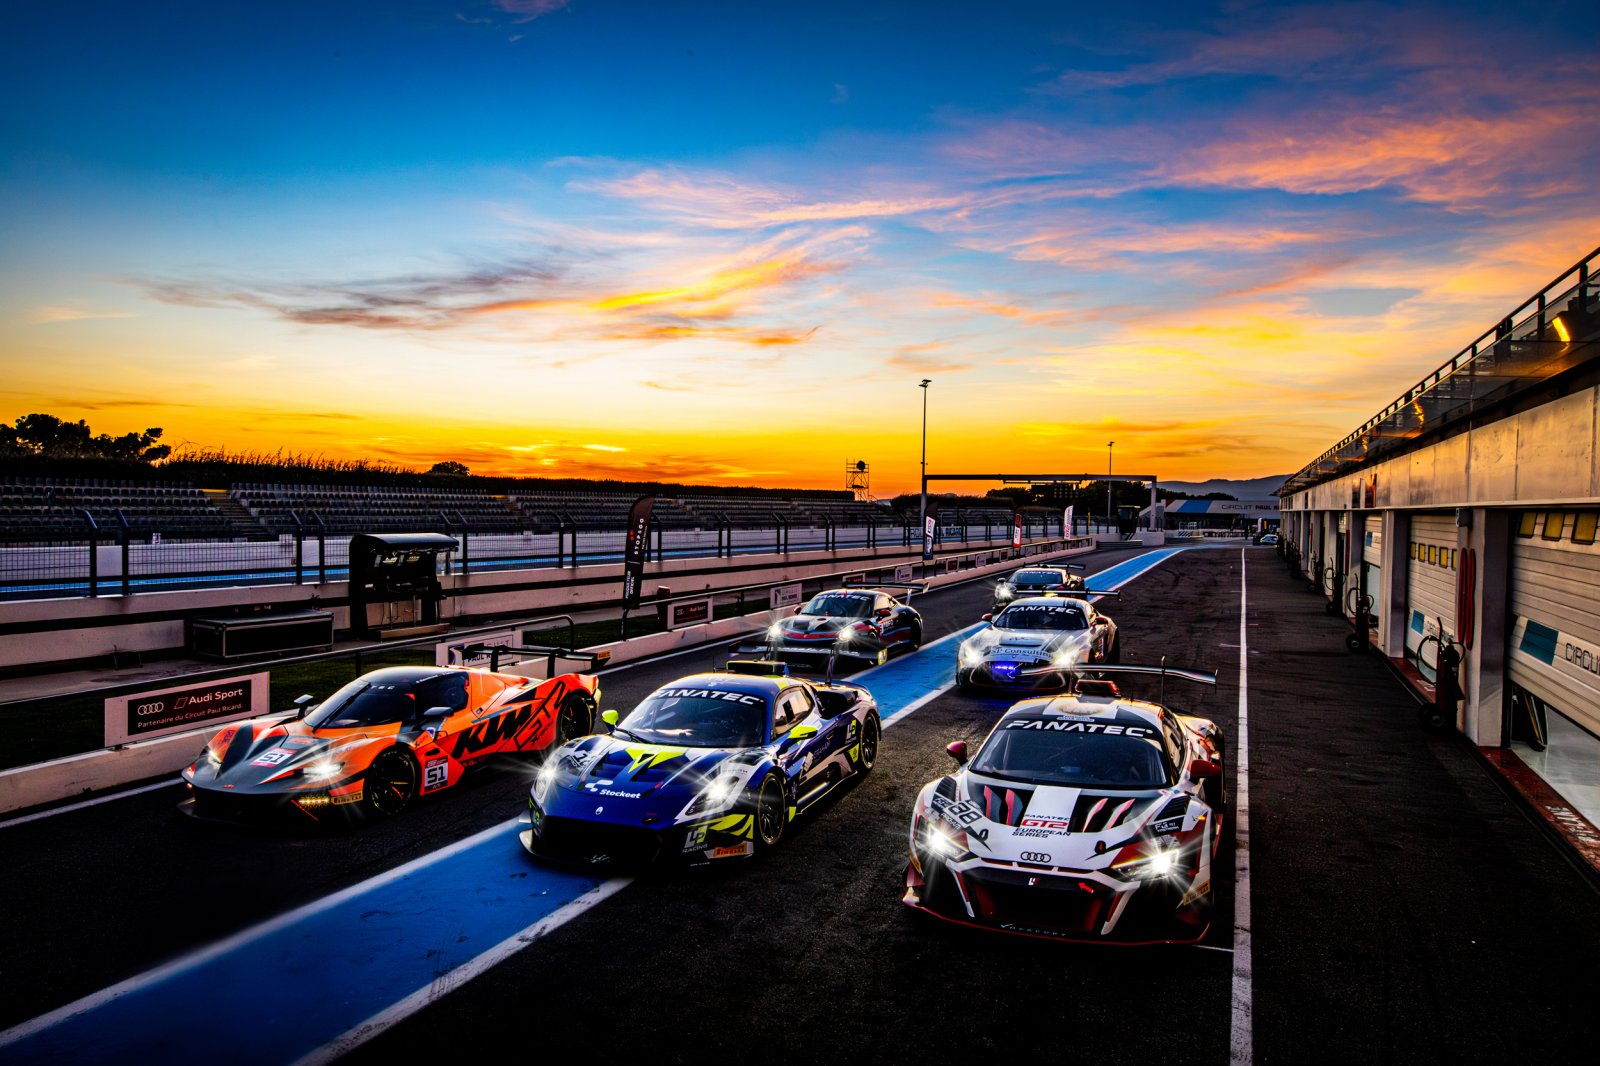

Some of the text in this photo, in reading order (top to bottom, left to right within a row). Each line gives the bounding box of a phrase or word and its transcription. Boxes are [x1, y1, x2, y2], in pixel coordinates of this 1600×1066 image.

[1007, 606, 1079, 615] FANATEC
[188, 689, 243, 705] Audi Sport
[137, 717, 173, 729] Partenaire
[185, 711, 206, 719] Circuit
[208, 706, 221, 715] Paul
[451, 703, 532, 760] KTM
[1006, 720, 1147, 737] FANATEC
[259, 752, 285, 763] 51
[427, 765, 446, 785] 51
[599, 788, 641, 799] Stockeet
[947, 802, 983, 825] 88
[1015, 828, 1072, 836] EUROPEAN
[1021, 819, 1069, 829] GT2
